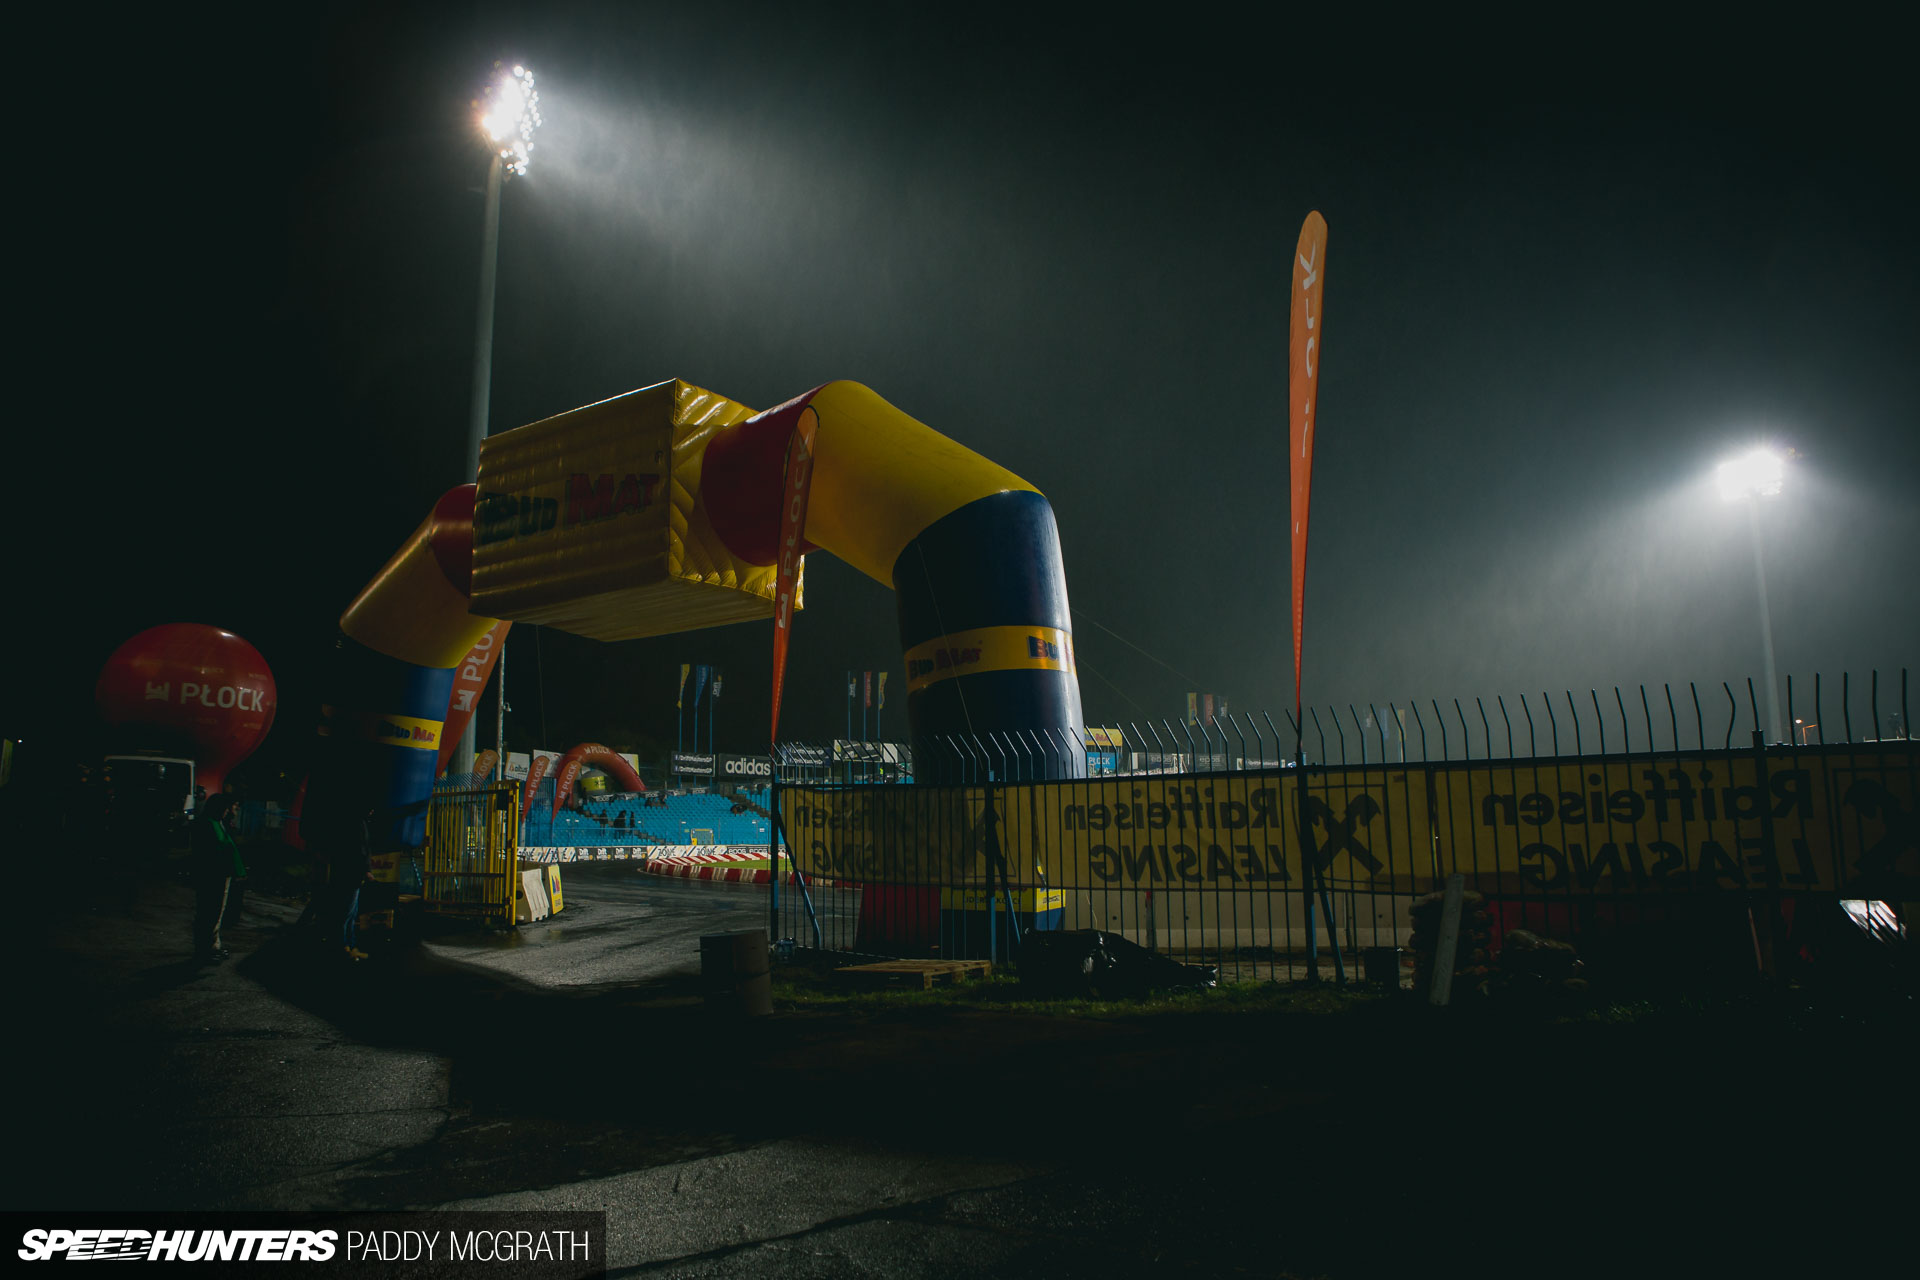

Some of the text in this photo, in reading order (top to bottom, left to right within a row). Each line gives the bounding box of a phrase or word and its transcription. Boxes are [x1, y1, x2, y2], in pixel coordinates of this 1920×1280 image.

[480, 473, 660, 545] BUD MAT
[462, 622, 498, 682] PŁO
[180, 682, 265, 712] PŁOCK
[725, 757, 771, 776] adidas
